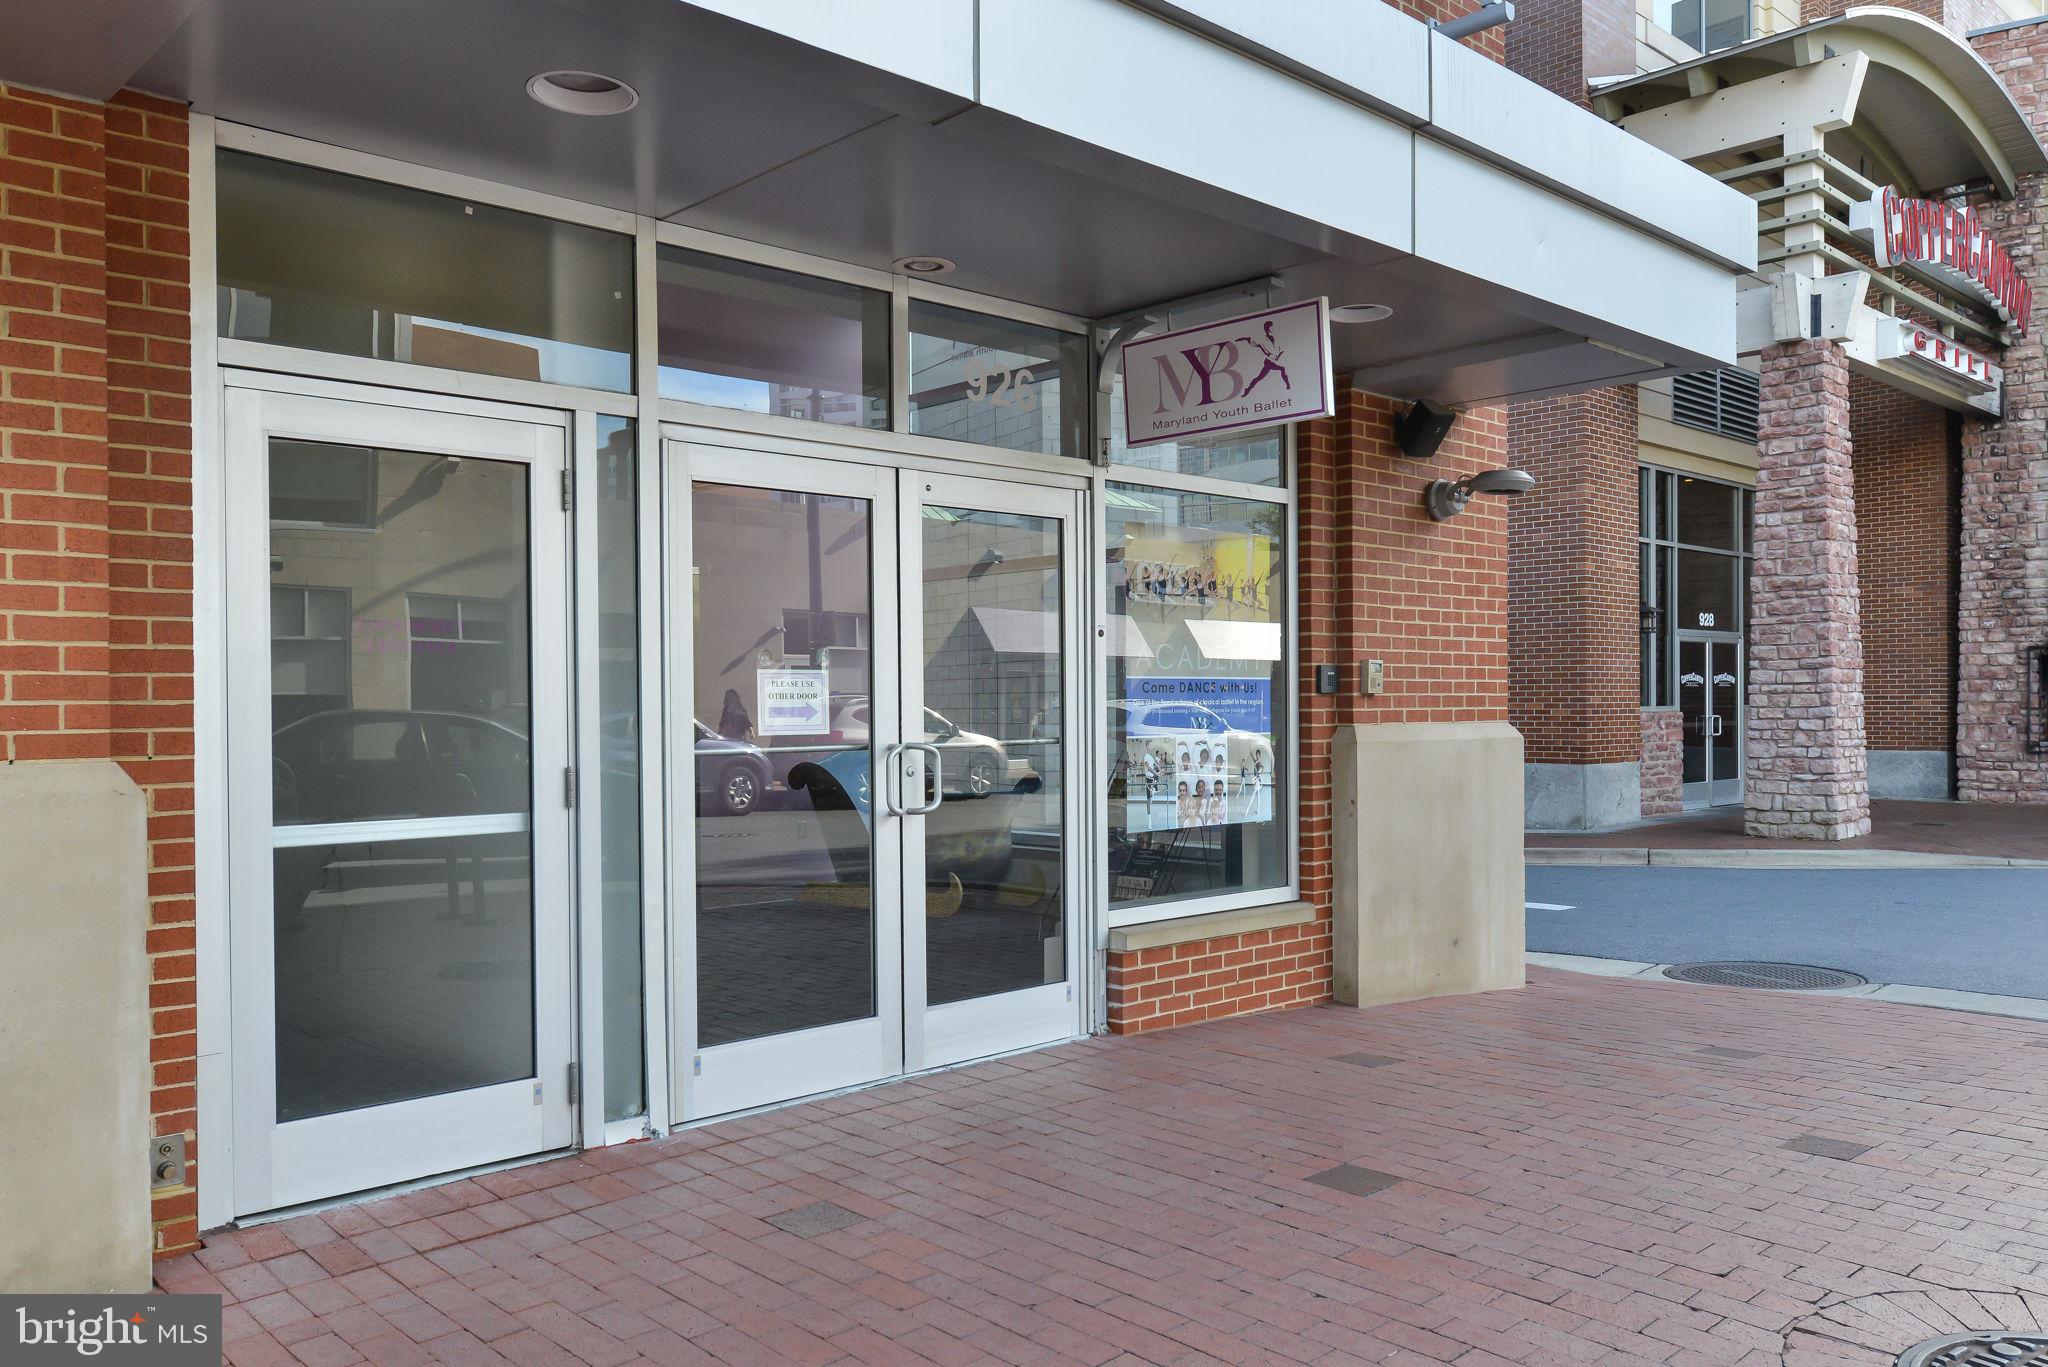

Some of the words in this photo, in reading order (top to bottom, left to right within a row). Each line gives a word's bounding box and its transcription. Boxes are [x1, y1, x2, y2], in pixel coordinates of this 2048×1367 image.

[1912, 330, 1994, 383] GRILL
[965, 359, 1037, 413] 926
[1151, 341, 1245, 415] MYB
[1152, 408, 1208, 431] Maryland
[1212, 404, 1249, 420] Youth
[1254, 398, 1293, 413] Ballet
[1698, 612, 1715, 627] 928
[768, 692, 795, 700] OTHER
[796, 692, 818, 700] DOOR
[771, 680, 800, 688] PLEASE
[801, 680, 815, 688] USE
[1142, 681, 1175, 694] Come
[1179, 681, 1216, 694] DANCE
[1219, 681, 1240, 694] with
[1243, 682, 1257, 694] Us!
